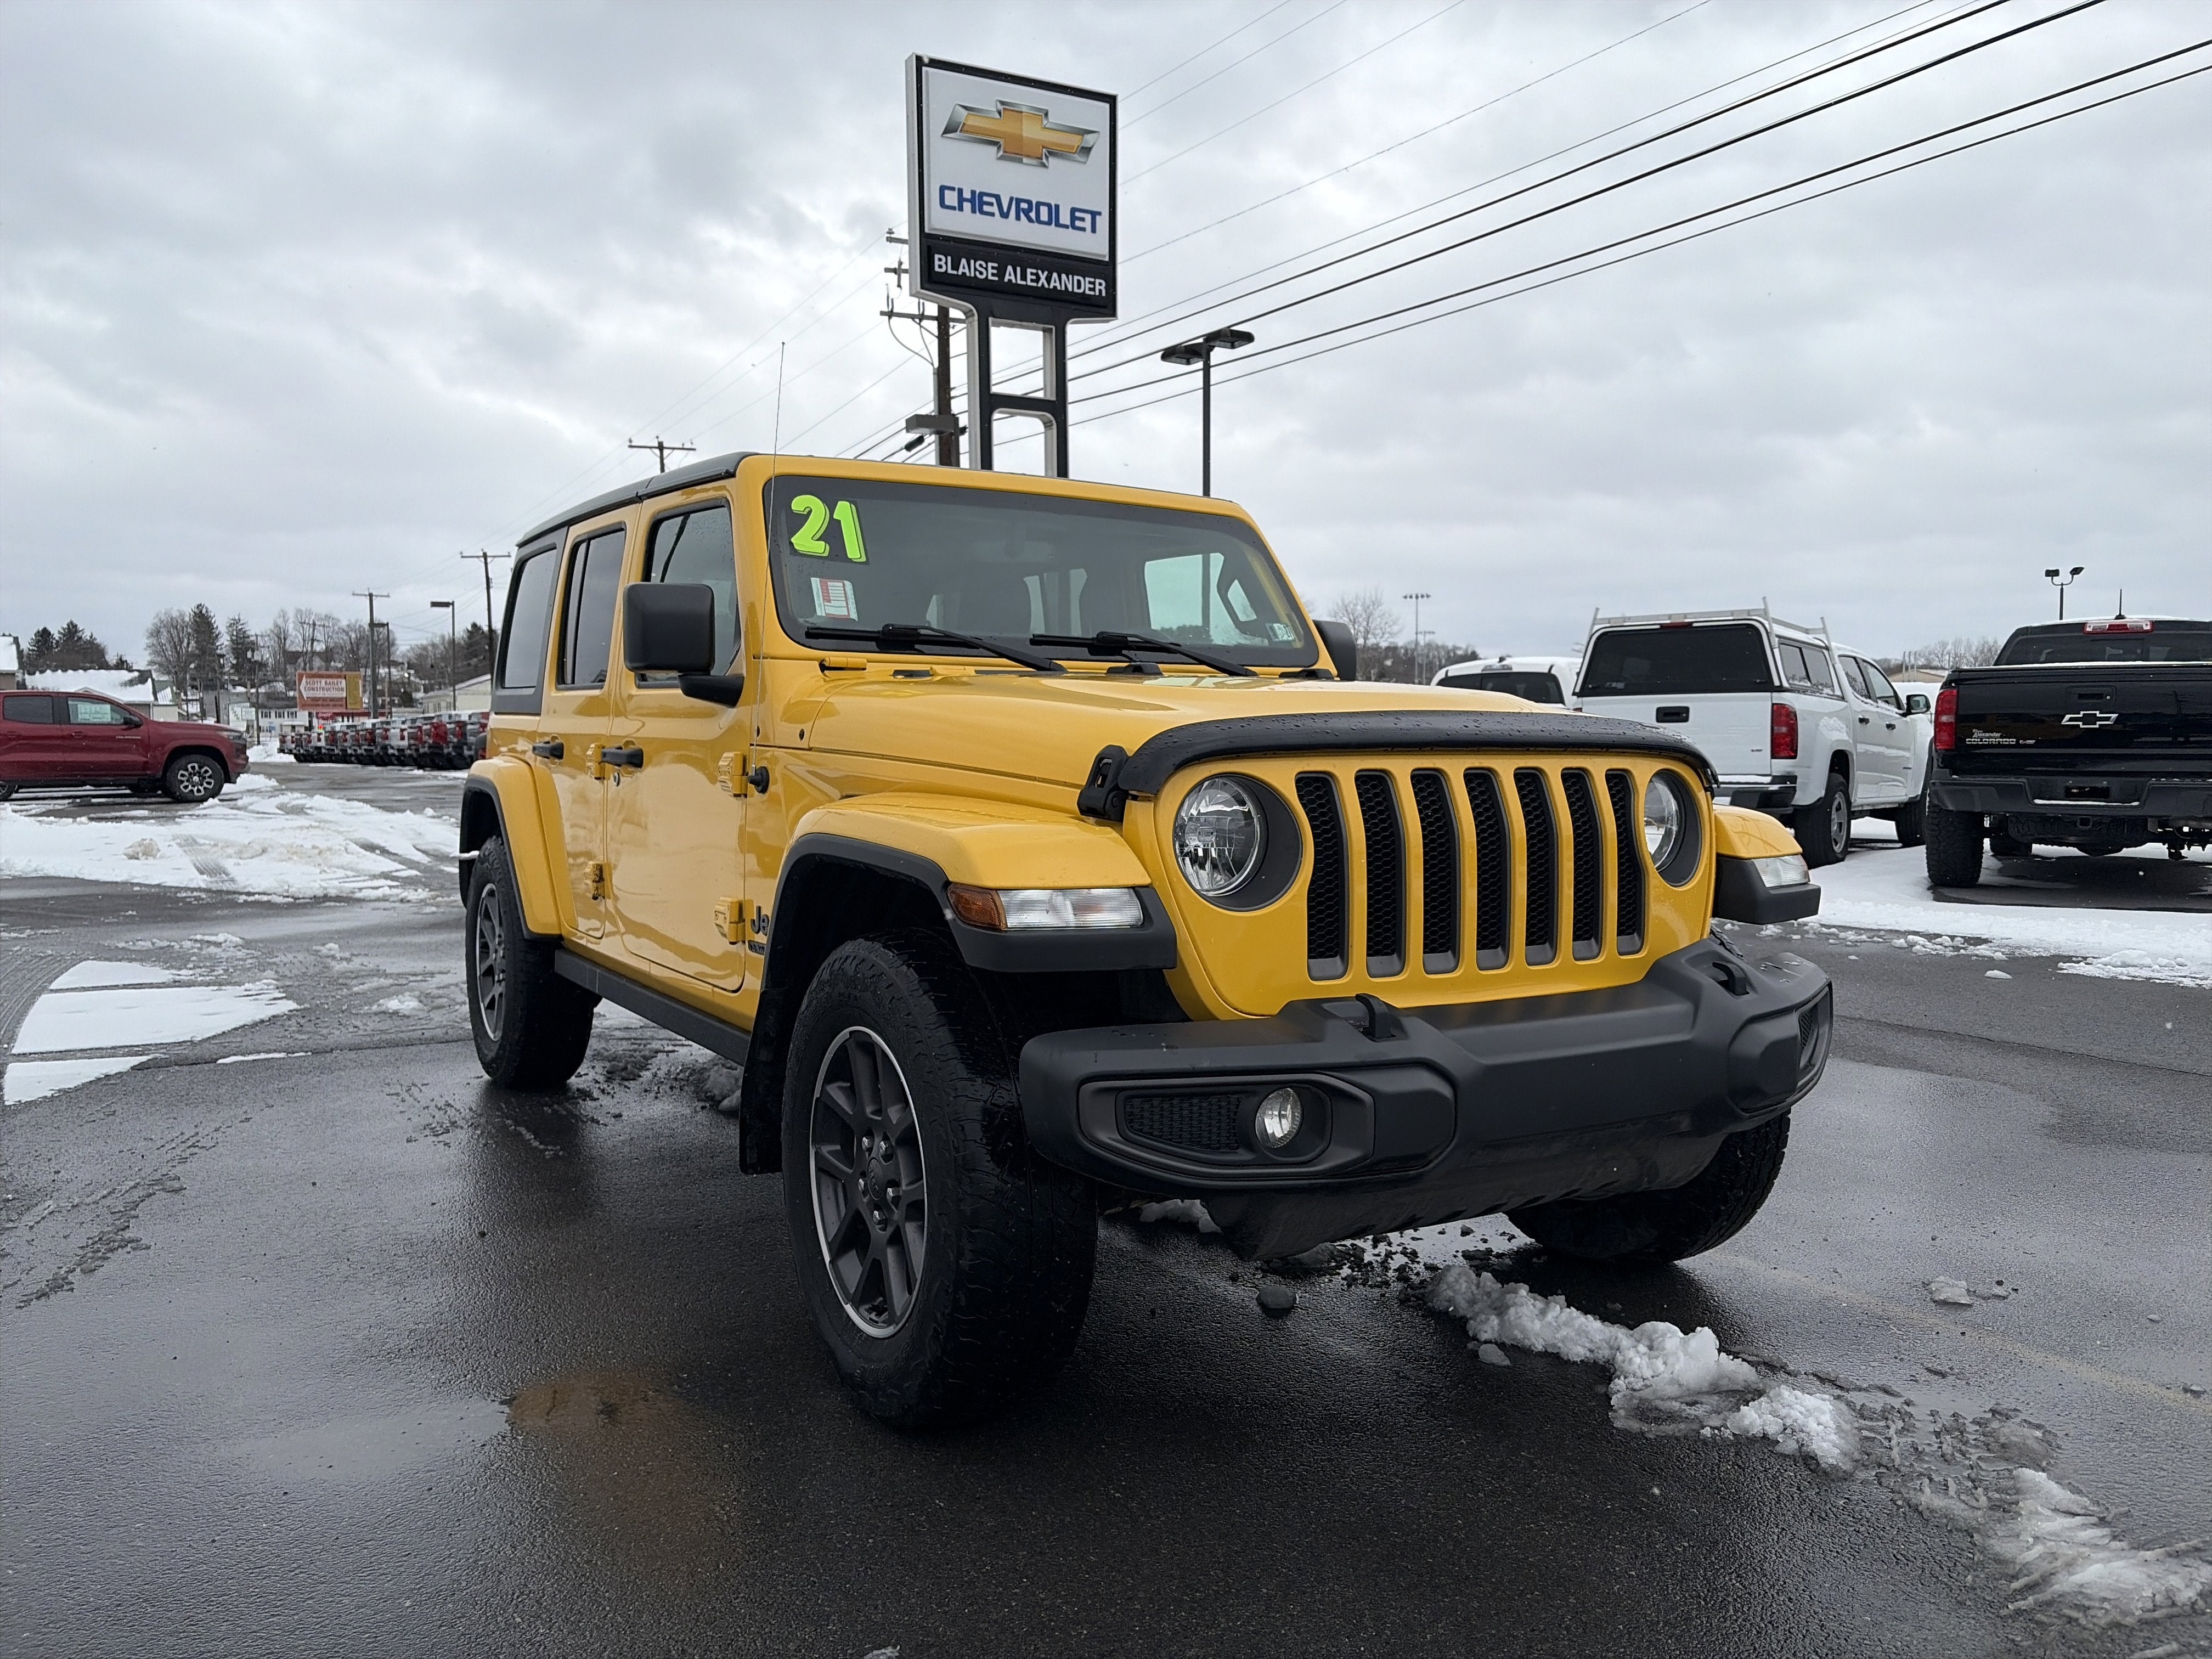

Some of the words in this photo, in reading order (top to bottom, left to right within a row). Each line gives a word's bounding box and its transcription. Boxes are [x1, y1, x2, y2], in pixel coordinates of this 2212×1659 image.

[939, 184, 1102, 234] CHEVROLET
[934, 253, 999, 281] BLAISE
[1004, 264, 1107, 297] ALEXANDER
[791, 494, 867, 562] 21
